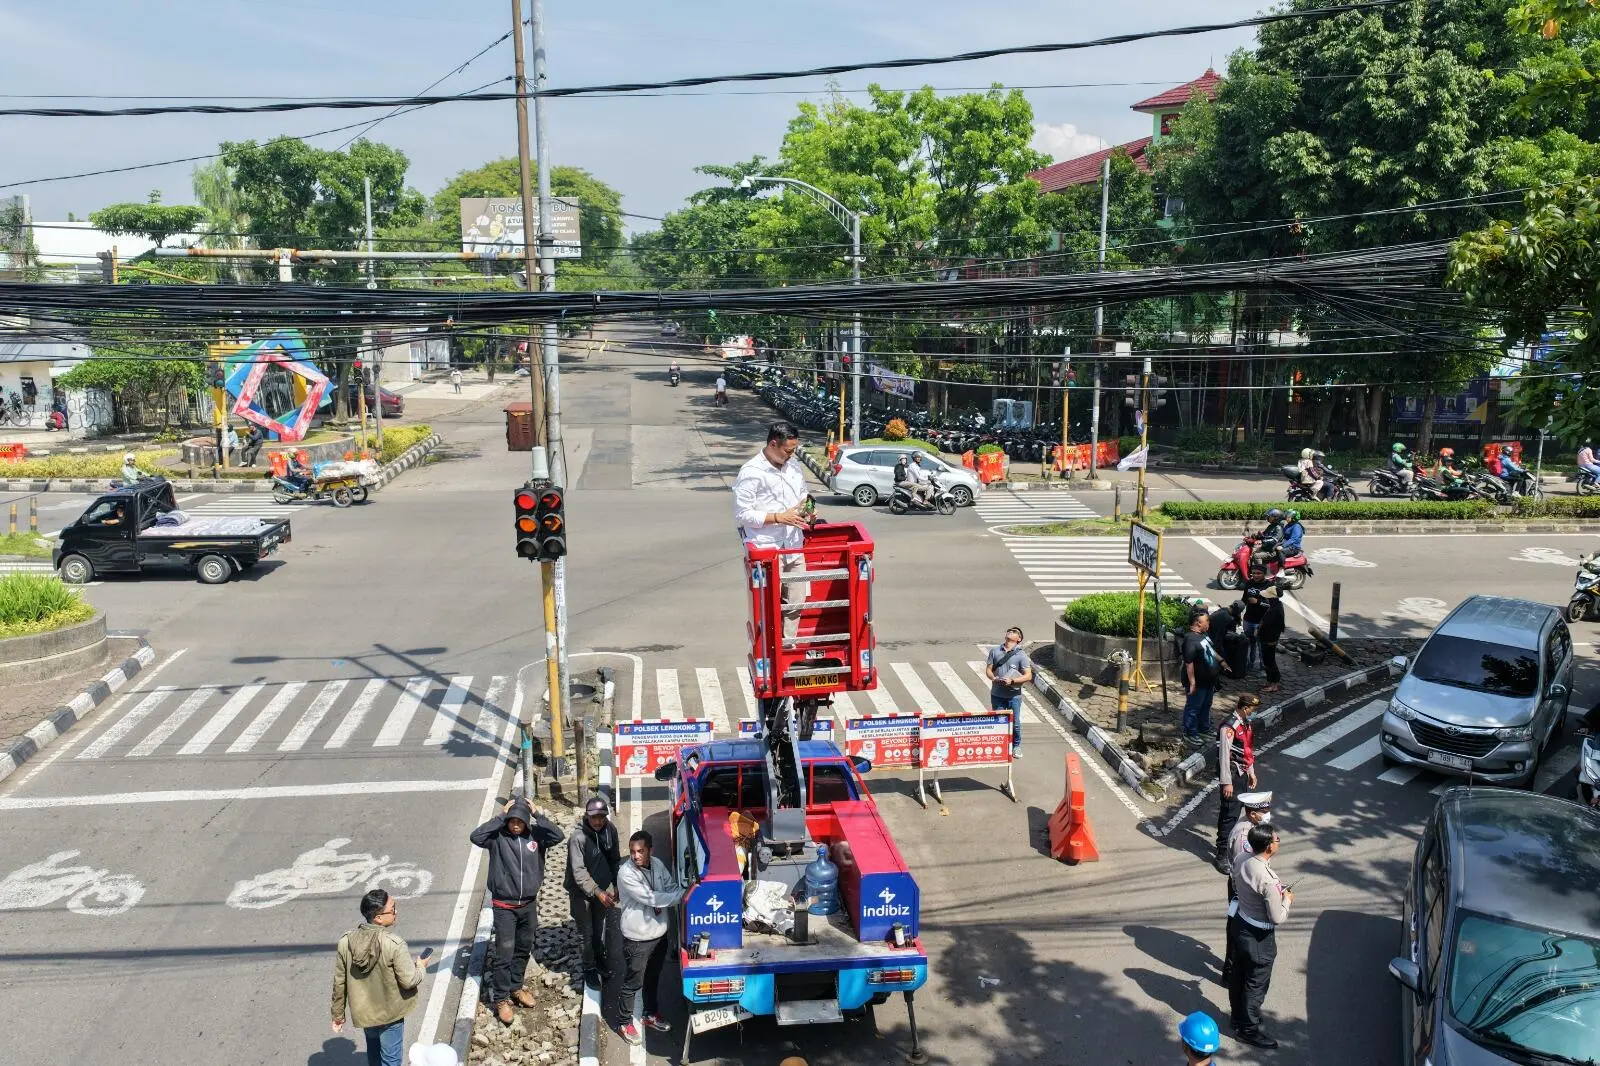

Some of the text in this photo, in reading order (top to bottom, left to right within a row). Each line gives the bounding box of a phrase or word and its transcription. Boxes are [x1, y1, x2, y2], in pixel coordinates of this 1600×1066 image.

[795, 675, 838, 687] MAX. 100 KG
[863, 903, 911, 917] indibiz
[690, 911, 739, 926] indibiz
[693, 1017, 701, 1027] L
